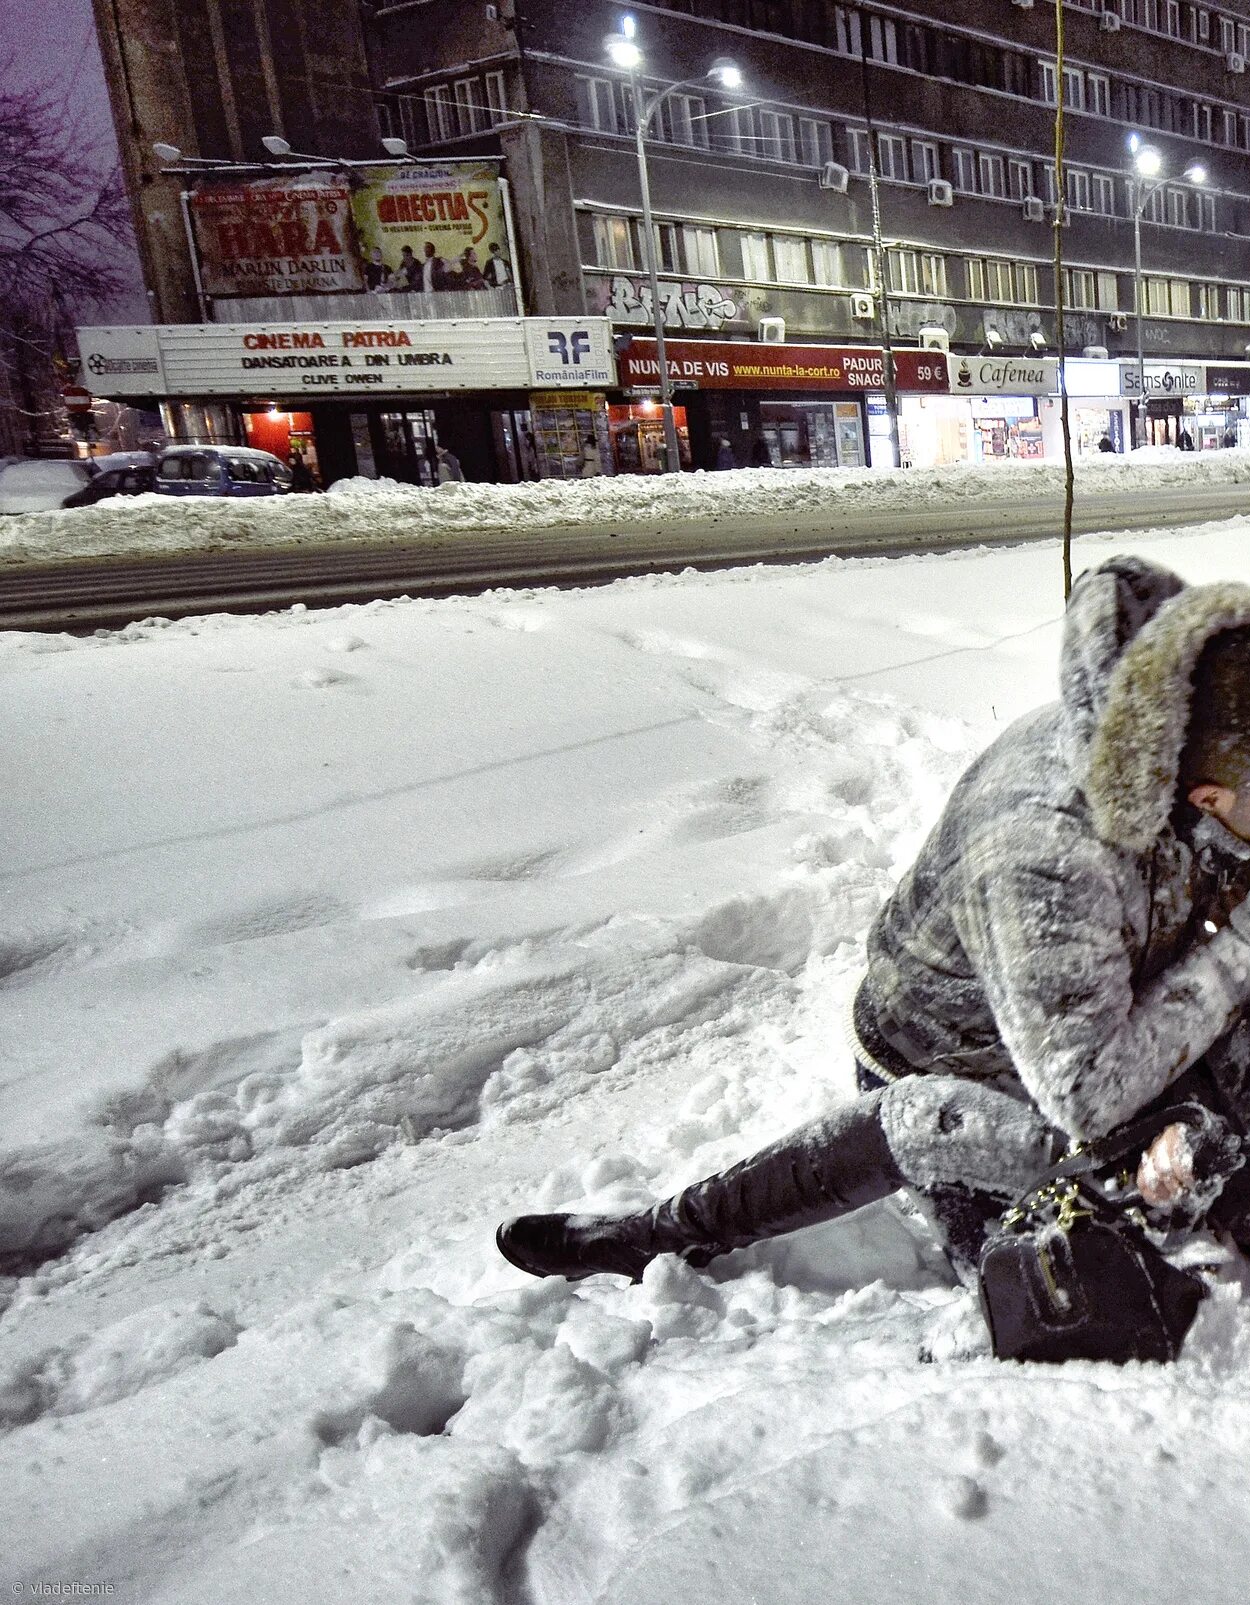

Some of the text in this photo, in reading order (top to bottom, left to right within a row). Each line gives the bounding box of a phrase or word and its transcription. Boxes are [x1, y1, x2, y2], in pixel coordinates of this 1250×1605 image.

[288, 258, 347, 275] DARLIN
[243, 331, 412, 350] CINEMA PATRIA
[365, 354, 390, 367] DIN
[397, 352, 453, 366] UMBRA
[536, 369, 608, 381] RomâniaFilm
[683, 362, 703, 376] DE
[705, 362, 729, 376] VIS
[733, 364, 840, 377] www.nunta-la-cort.ro
[917, 366, 943, 380] 59 €
[979, 361, 1044, 389] Cafenea
[302, 373, 383, 385] CLIVE OWEN
[1124, 370, 1196, 392] Samsonite
